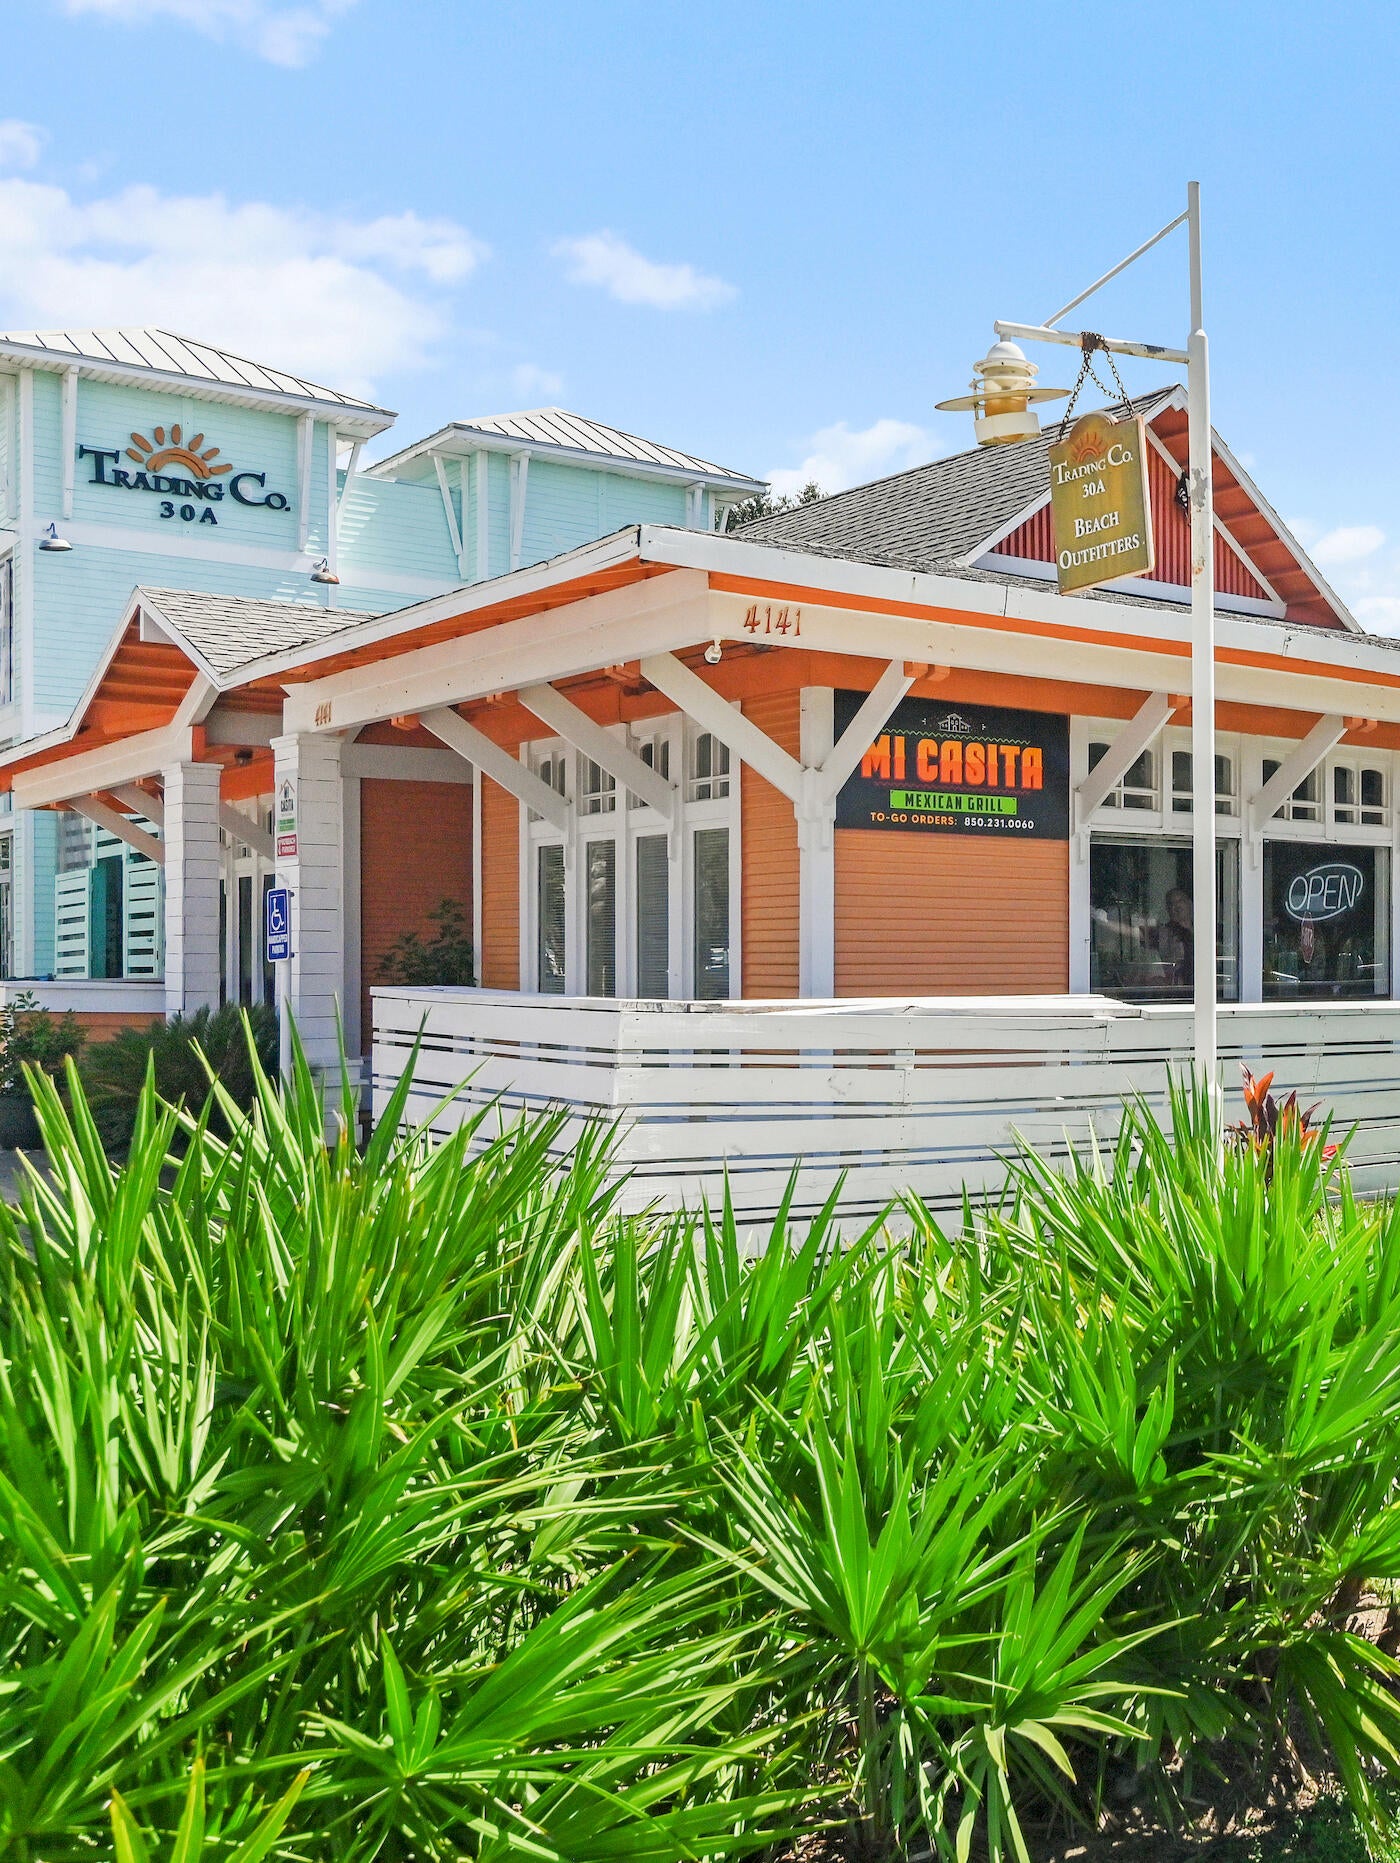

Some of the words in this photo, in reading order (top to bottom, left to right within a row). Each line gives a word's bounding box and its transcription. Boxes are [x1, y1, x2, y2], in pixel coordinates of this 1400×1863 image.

[79, 444, 224, 502] TRADING
[1052, 457, 1107, 485] TRADING
[1082, 478, 1106, 499] 30A
[159, 501, 218, 525] 30A
[1073, 510, 1121, 539] BEACH
[1058, 533, 1140, 570] OUTFITTERS
[743, 603, 801, 637] 4141
[860, 734, 906, 781] MI
[916, 737, 1044, 791] CASITA
[904, 793, 963, 811] MEXICAN
[967, 797, 1004, 813] GRILL
[870, 811, 908, 823] TO-GO
[911, 813, 959, 826] ORDERS:
[964, 816, 1035, 830] 850.231.0060
[1288, 874, 1358, 911] OPEN
